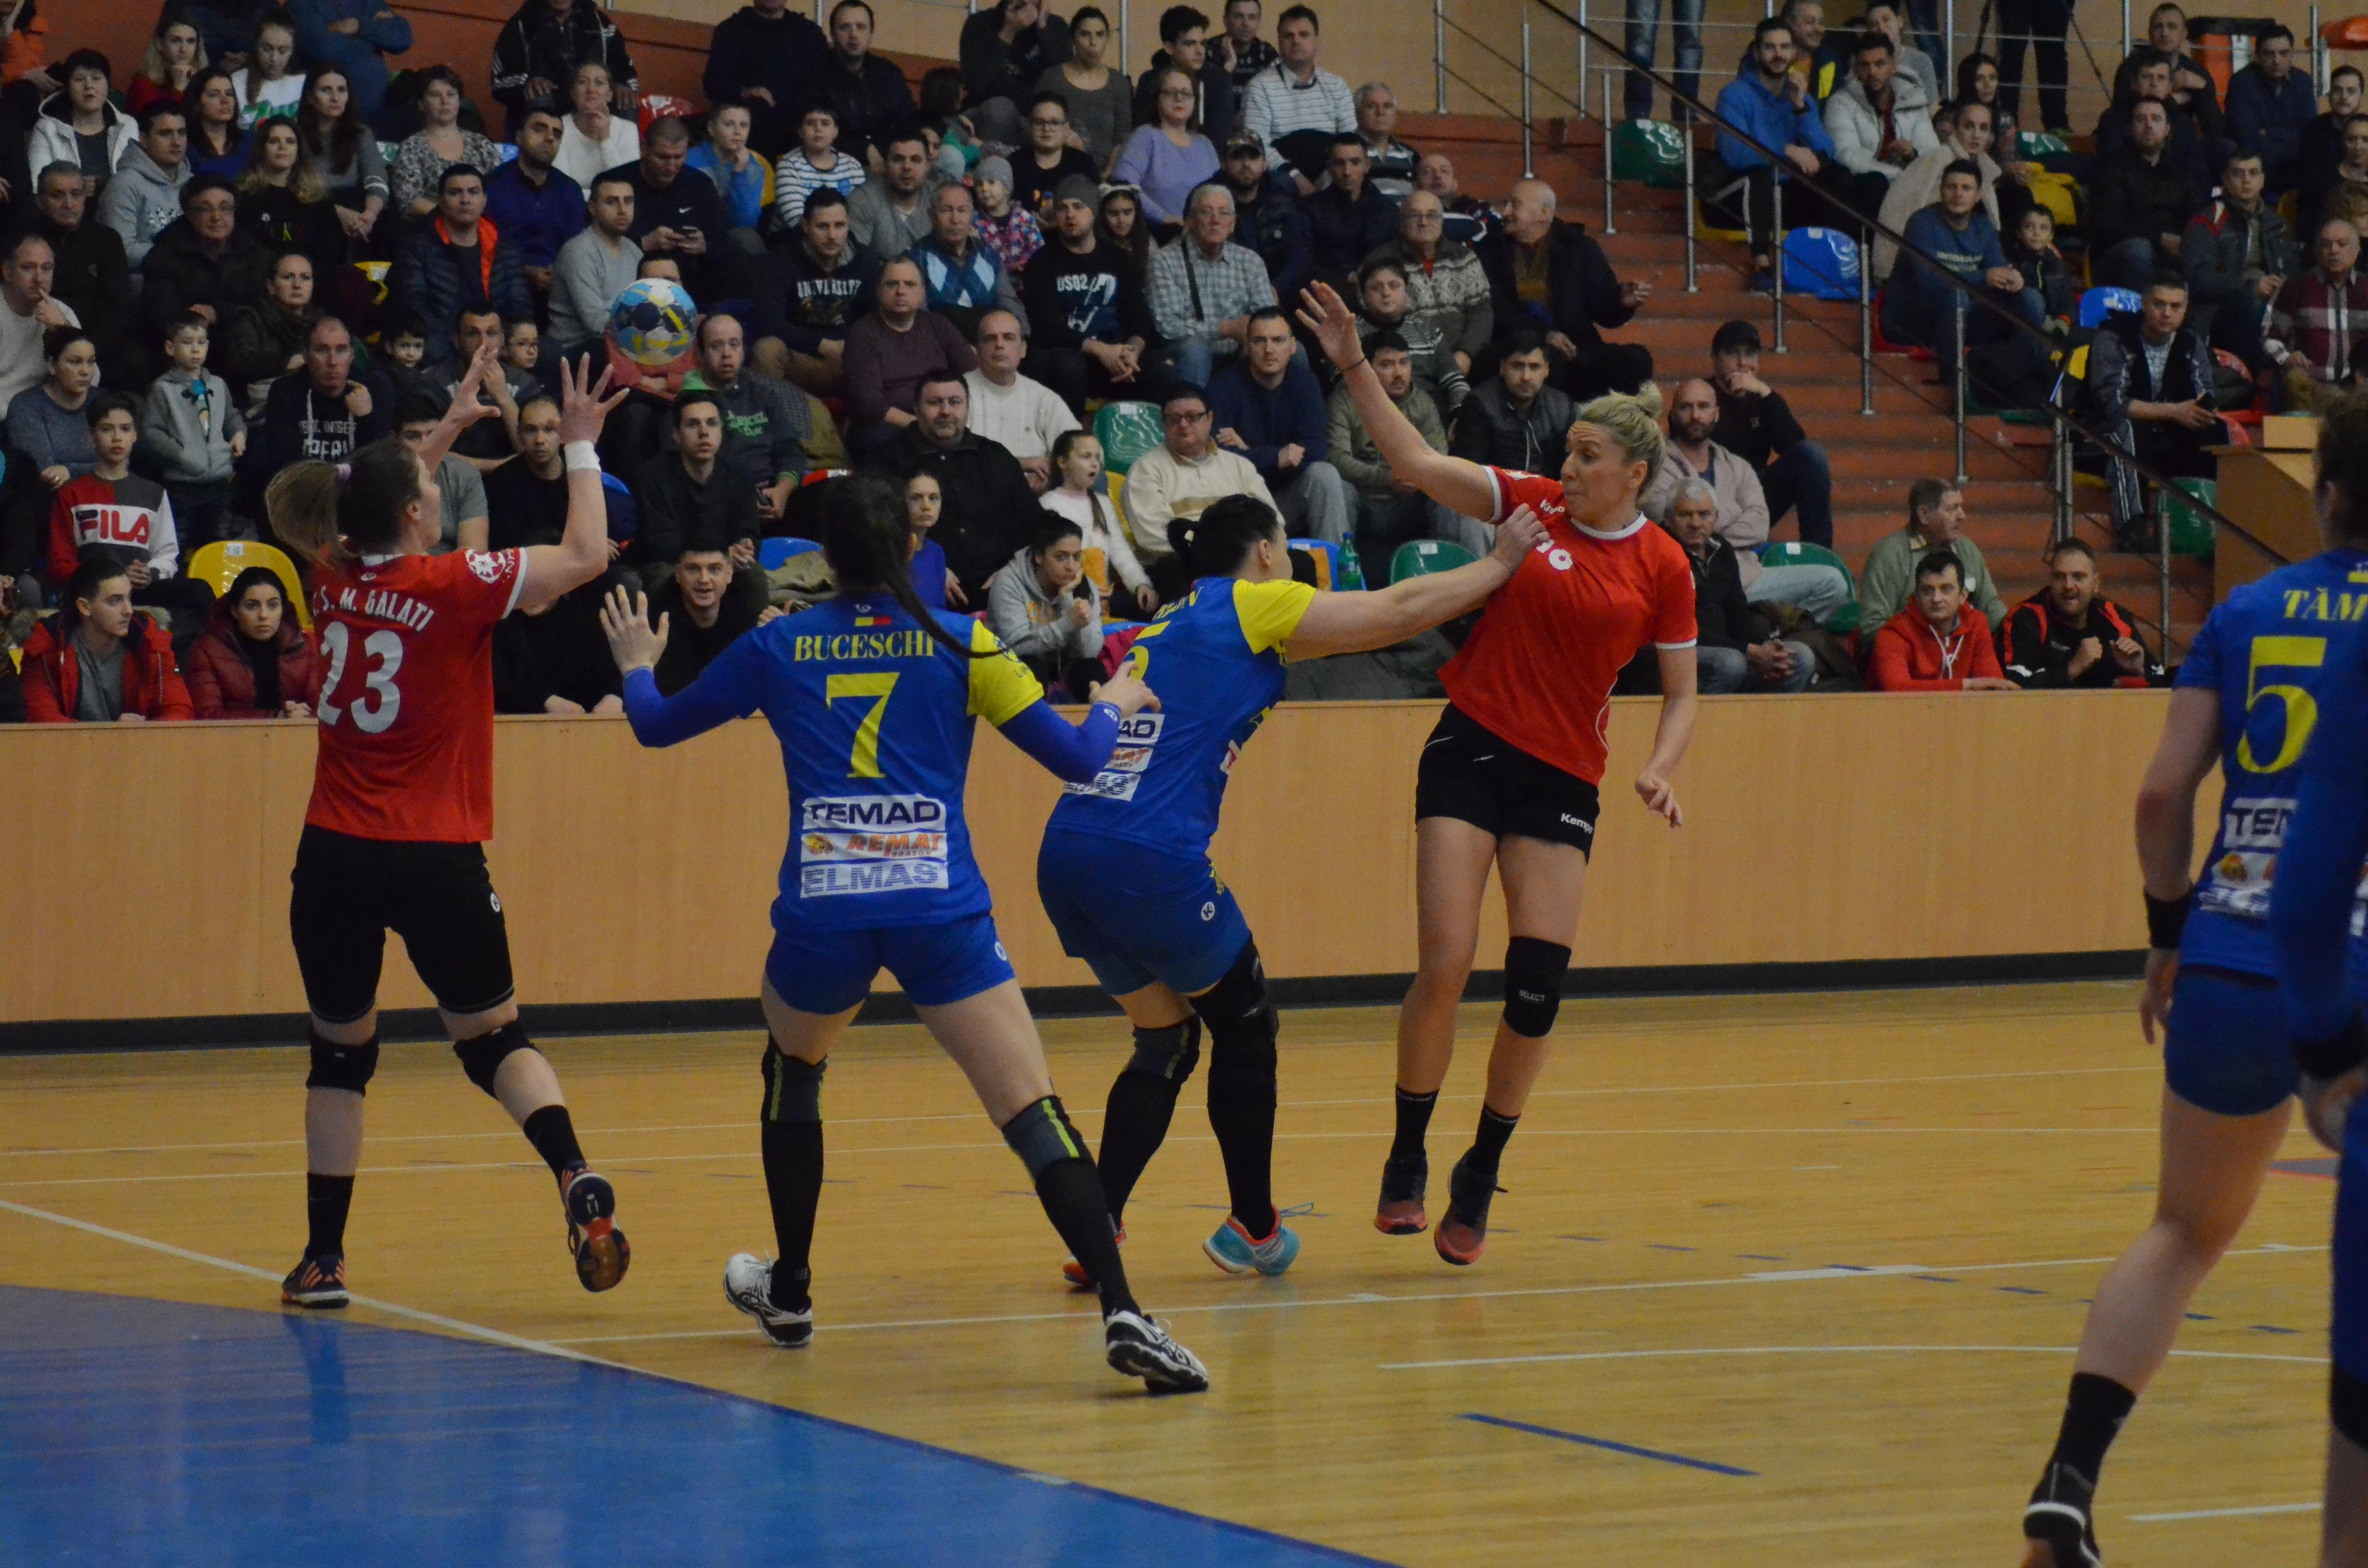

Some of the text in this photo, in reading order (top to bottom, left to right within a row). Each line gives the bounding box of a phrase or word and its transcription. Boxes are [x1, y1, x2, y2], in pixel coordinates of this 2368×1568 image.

[75, 509, 149, 545] FILA
[365, 589, 434, 632] GALATI
[794, 630, 935, 662] BUCESCHI
[317, 621, 403, 733] 23
[2237, 635, 2328, 773] 5
[826, 672, 900, 778] 7
[805, 801, 940, 825] TEMAD
[1561, 813, 1593, 834] Kempa
[846, 833, 943, 857] REMAT
[804, 864, 938, 894] ELMAS
[1519, 990, 1545, 1002] SELECT
